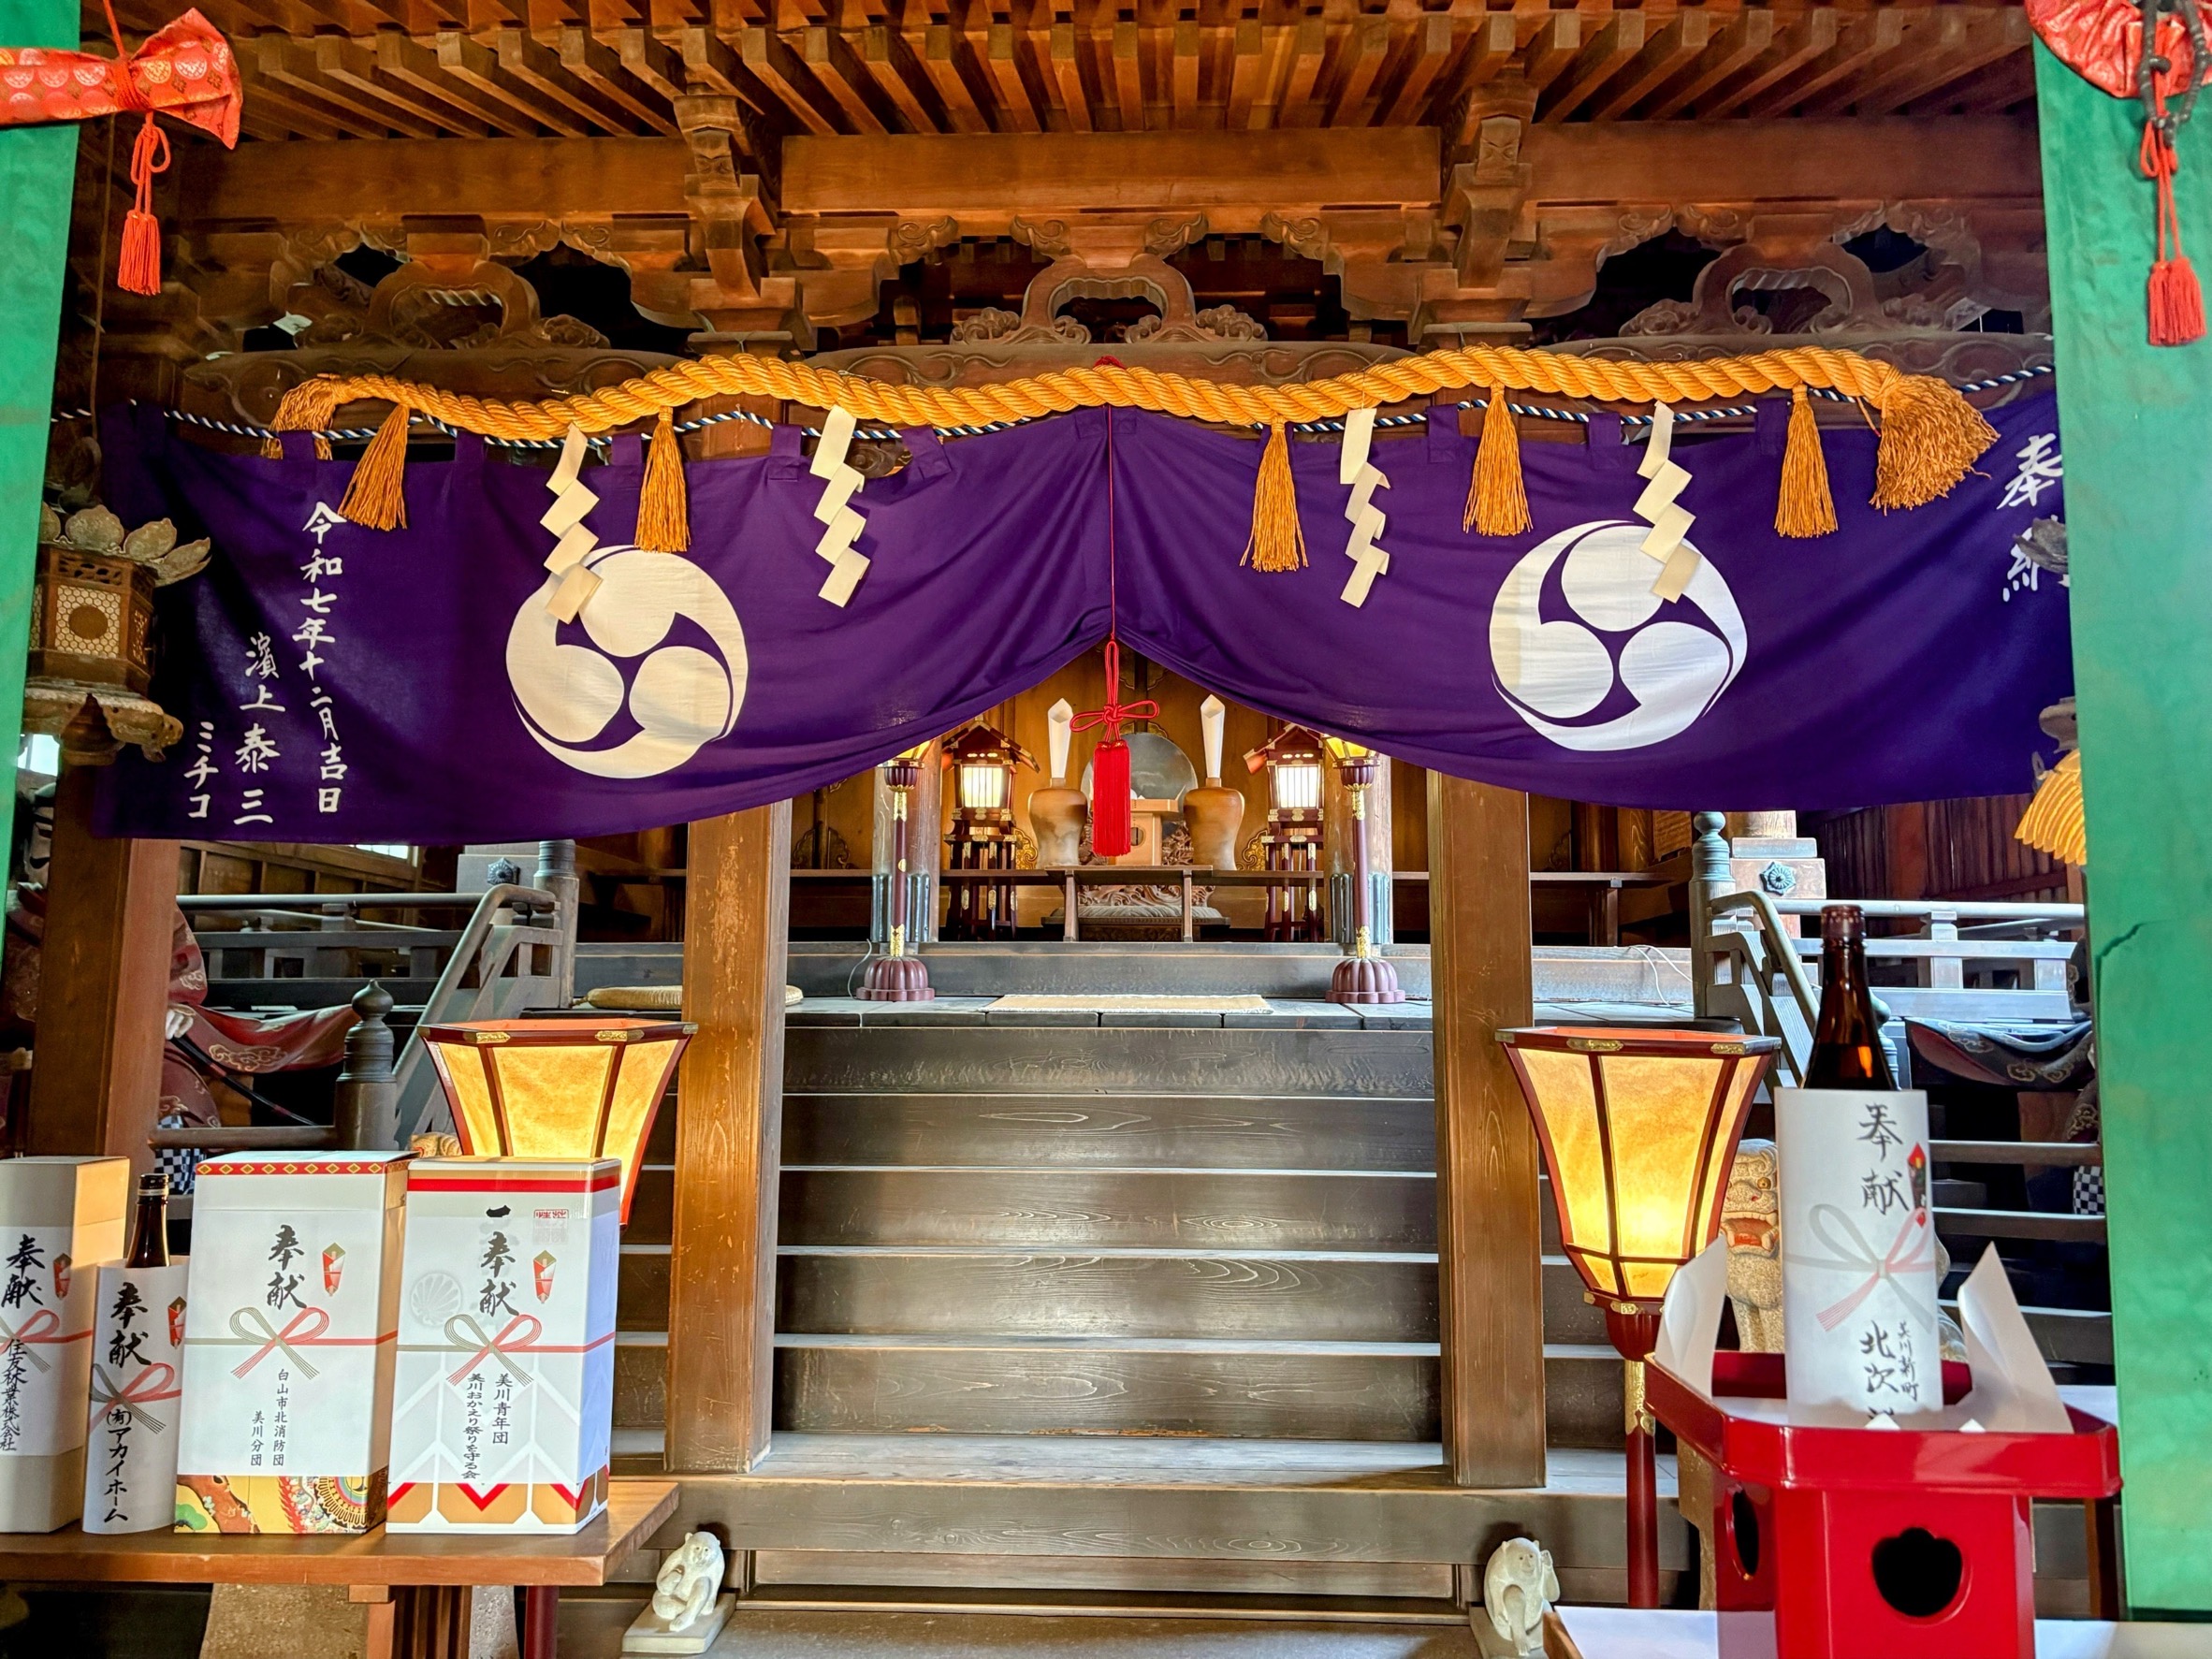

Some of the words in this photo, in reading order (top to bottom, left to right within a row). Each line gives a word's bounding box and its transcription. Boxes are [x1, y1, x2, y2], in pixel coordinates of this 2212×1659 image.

[292, 501, 347, 813] 令和七年十二月吉日
[183, 721, 219, 818] ミチコ
[233, 632, 285, 824] 濱上泰三
[1856, 1102, 1910, 1216] 奉献
[1, 1233, 45, 1309] 奉献
[267, 1224, 307, 1310] 奉献
[479, 1230, 520, 1317] 奉献
[109, 1282, 152, 1369] 奉献
[1859, 1319, 1899, 1419] 北次
[0, 1338, 29, 1451] 住友林業株式会社
[250, 1410, 265, 1467] 美川分団
[272, 1368, 289, 1467] 白山市北消防団
[460, 1372, 486, 1480] 美川おかえり祭りを守る会
[491, 1372, 514, 1445] 美川青年団
